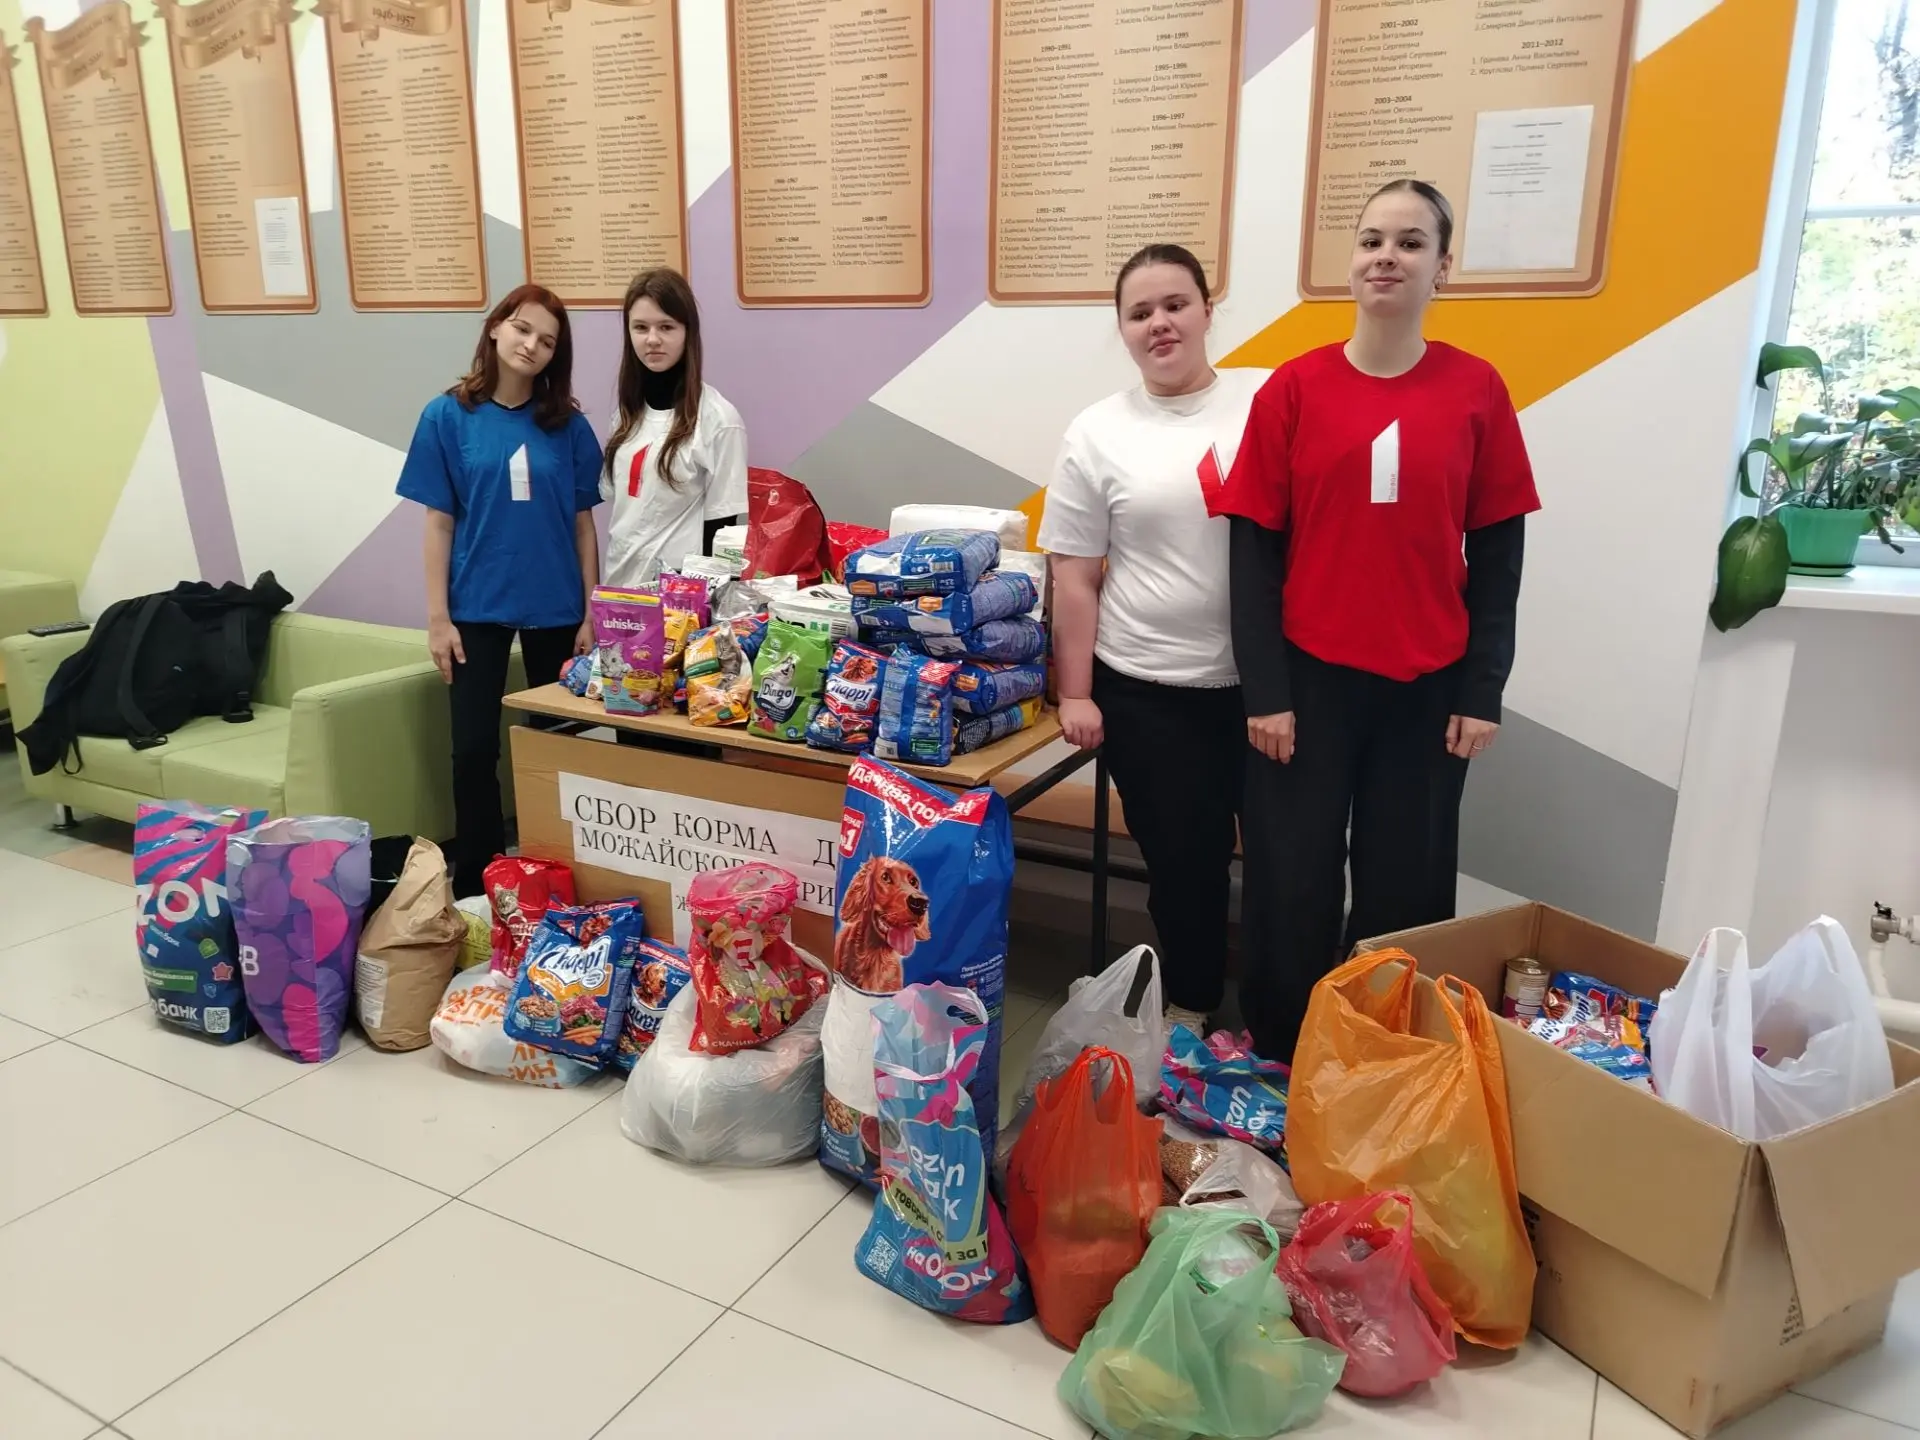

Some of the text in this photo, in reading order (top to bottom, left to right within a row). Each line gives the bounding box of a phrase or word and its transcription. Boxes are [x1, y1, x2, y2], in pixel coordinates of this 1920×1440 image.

[371, 7, 417, 27] 1946-1957
[1380, 18, 1419, 30] 2001-2002
[1521, 38, 1564, 49] 2011-2012
[1373, 95, 1413, 105] 2003-2004
[1152, 112, 1186, 122] 1996-1997
[1150, 142, 1184, 151] 1997-1998
[1368, 159, 1407, 168] 2004-2005
[1148, 191, 1181, 200] 1998-1999
[602, 617, 647, 632] whiskas
[763, 683, 792, 703] Dingo
[574, 793, 657, 835] СБОР
[674, 811, 779, 855] КОРМА
[537, 944, 605, 975] Chappi
